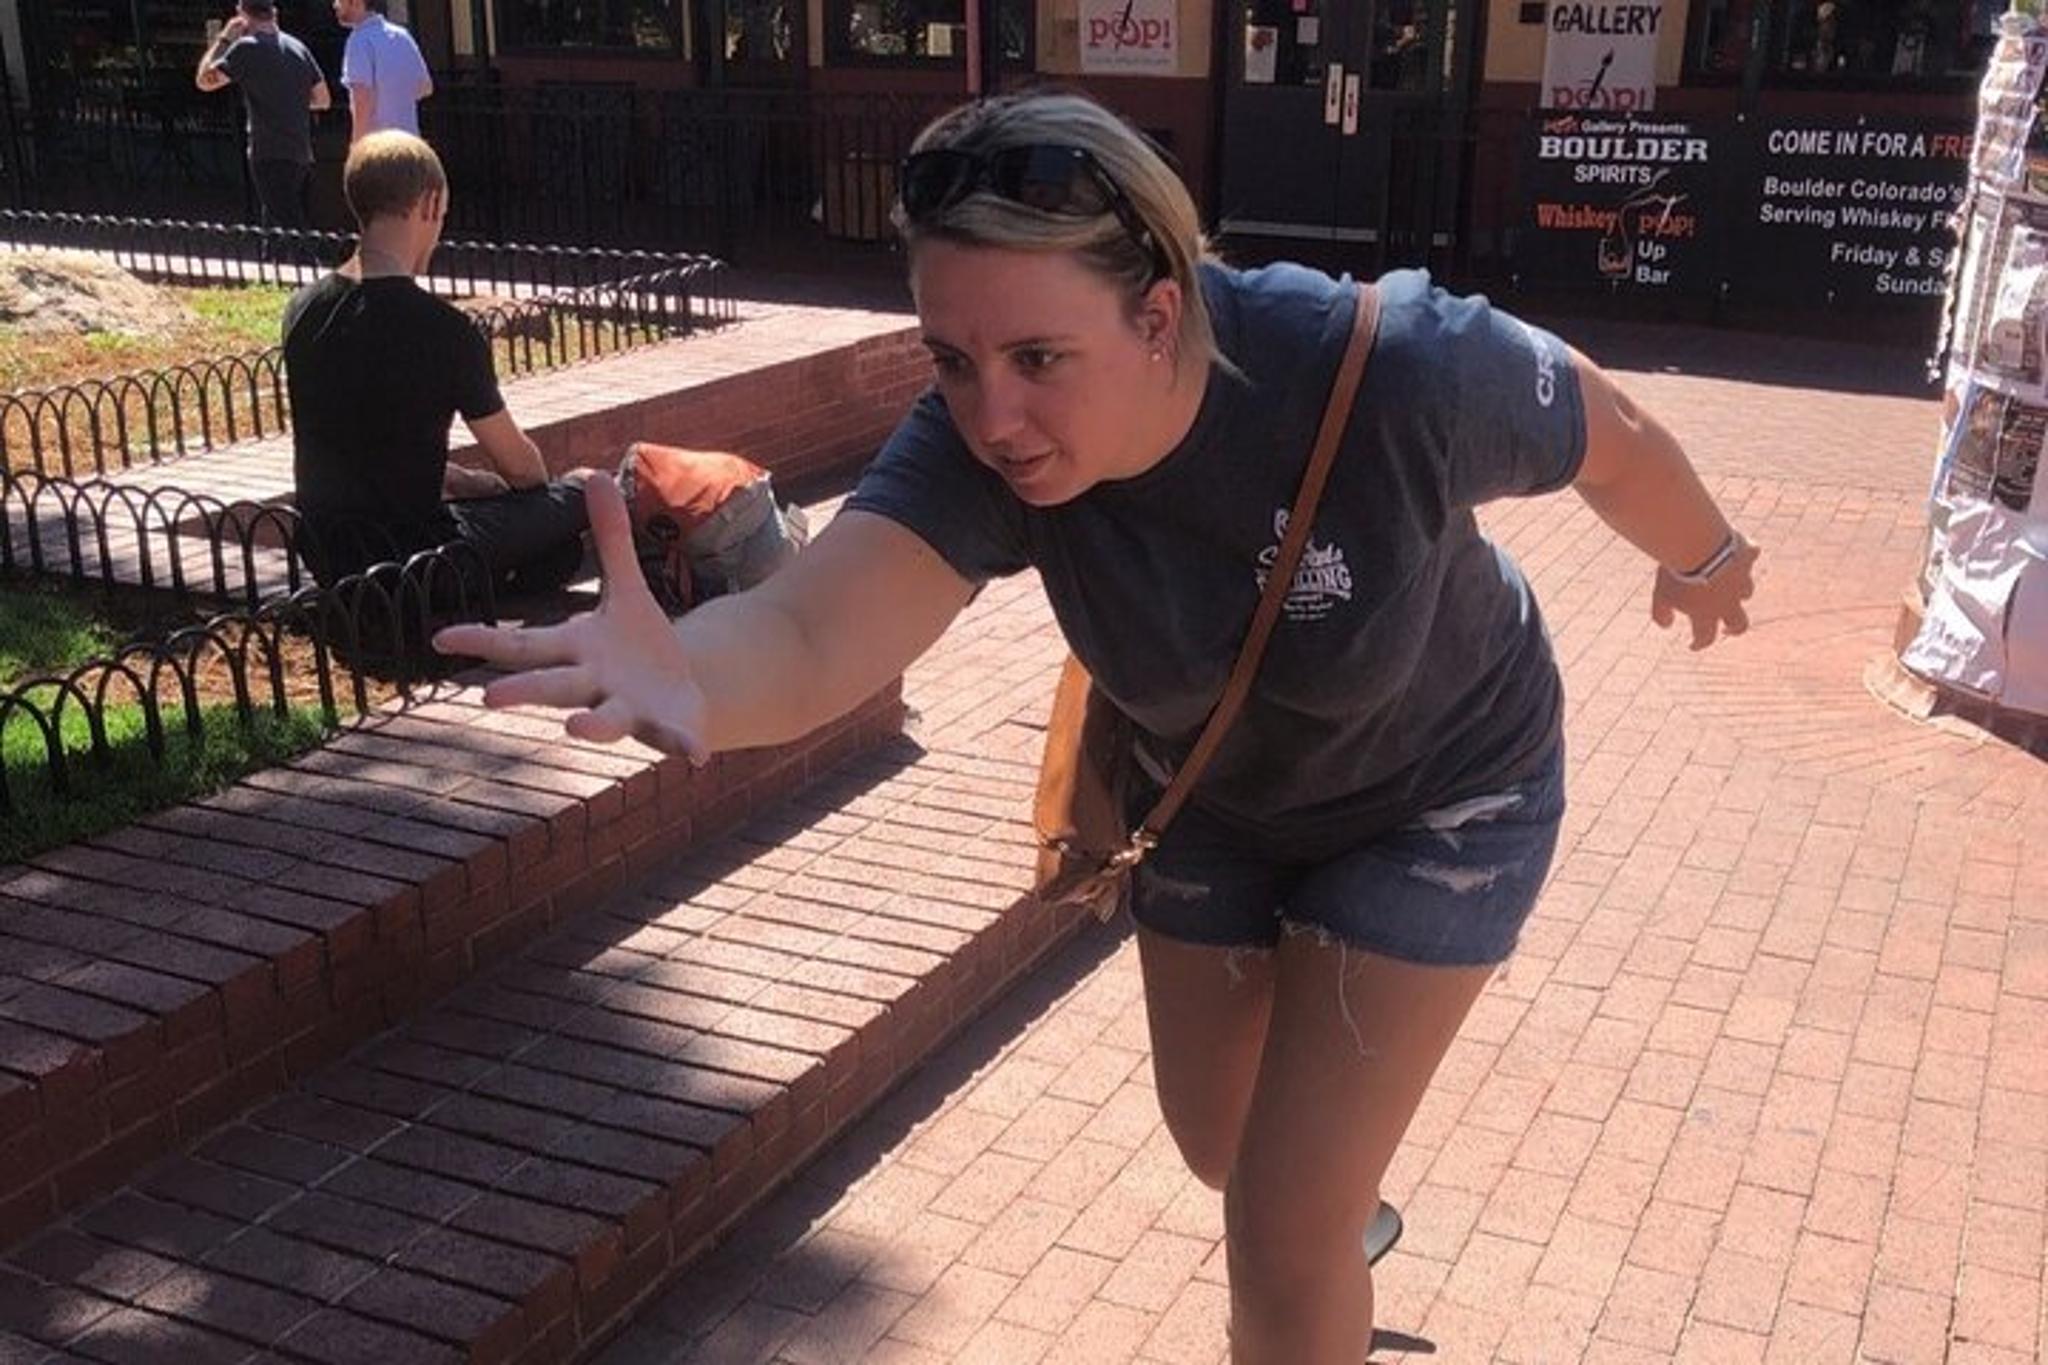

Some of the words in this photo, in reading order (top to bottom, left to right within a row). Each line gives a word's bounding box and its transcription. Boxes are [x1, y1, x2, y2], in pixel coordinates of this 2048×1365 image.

[1552, 4, 1661, 35] GALLERY
[1581, 119, 1627, 134] Gallery
[1539, 136, 1708, 161] BOULDER
[1768, 130, 1831, 154] COME
[1835, 132, 1859, 154] IN
[1862, 133, 1907, 156] FOR
[1910, 134, 1926, 157] A
[1574, 164, 1651, 184] SPIRITS
[1764, 176, 1844, 197] Boulder
[1851, 178, 1964, 203] Colorado's
[1537, 203, 1617, 236] Whiskey
[1760, 204, 1835, 228] Serving
[1842, 206, 1926, 231] Whiskey
[1638, 240, 1666, 262] Up
[1831, 243, 1899, 268] Friday
[1905, 247, 1921, 266] &
[1636, 265, 1671, 284] Bar
